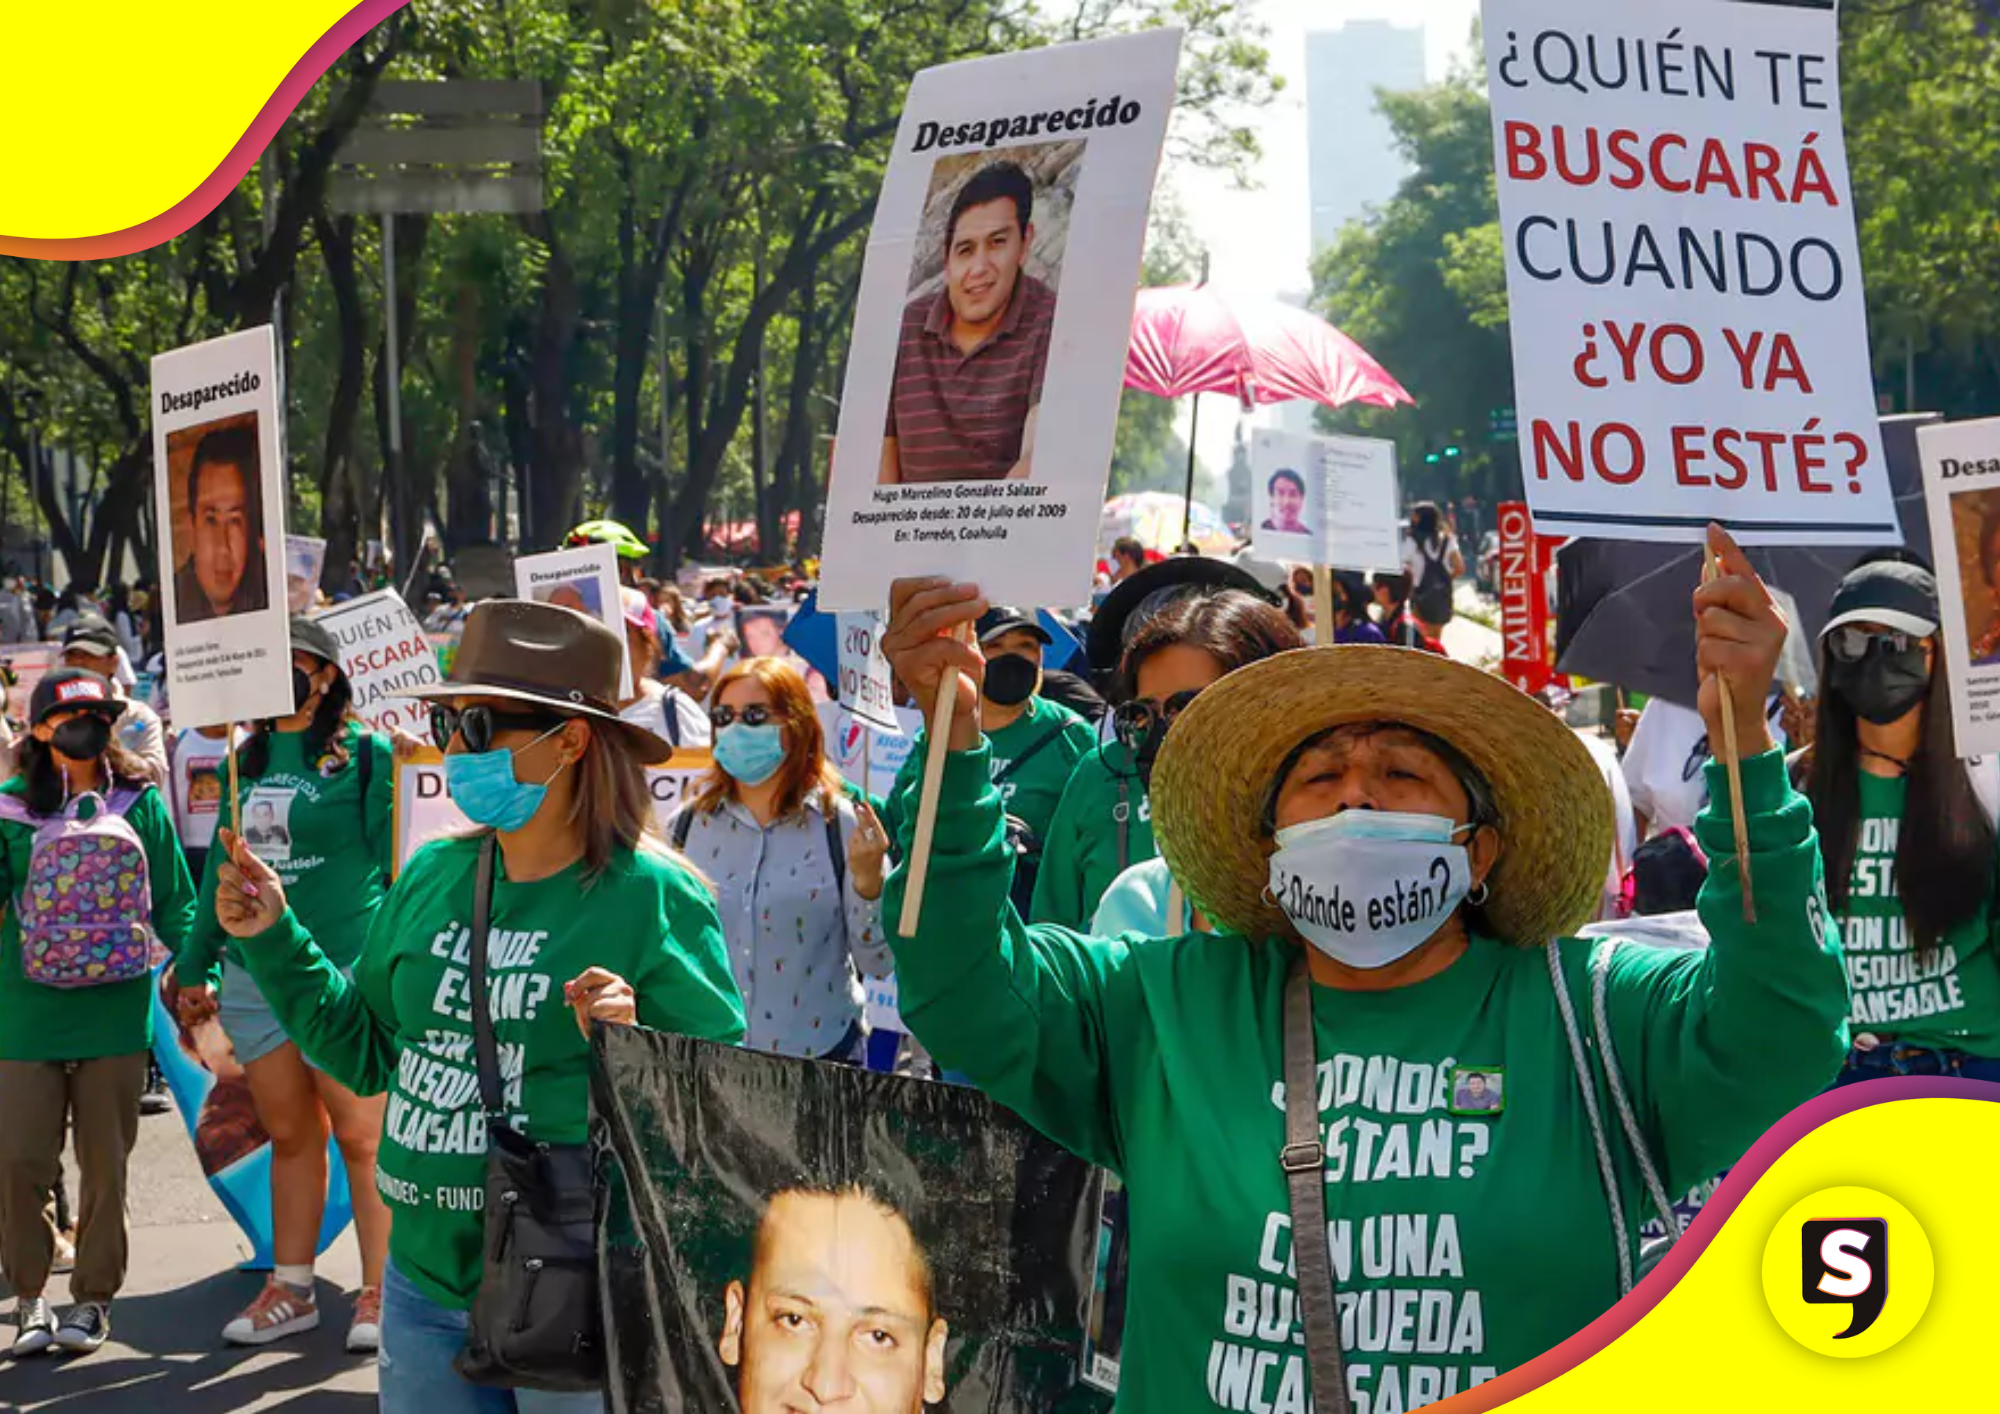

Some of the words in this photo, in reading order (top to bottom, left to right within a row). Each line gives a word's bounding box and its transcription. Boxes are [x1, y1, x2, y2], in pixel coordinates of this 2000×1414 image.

[1499, 27, 1735, 101] ¿QUIÉN
[1754, 51, 1828, 109] TE
[911, 94, 1142, 153] Desaparecido
[1504, 119, 1839, 206] BUSCARÁ
[1516, 215, 1843, 300] CUANDO
[1573, 320, 1705, 388] ¿YO
[1721, 327, 1814, 393] YA
[160, 370, 262, 415] Desaparecido
[1531, 419, 1646, 484] NO
[1670, 418, 1868, 494] ESTÉ?
[852, 507, 918, 525] Desaparecido
[920, 505, 954, 521] desde:
[957, 505, 970, 520] 20
[973, 504, 986, 519] de
[988, 503, 1014, 521] julio
[1016, 503, 1034, 518] del
[1037, 503, 1067, 518] 2009
[872, 488, 899, 504] Hugo
[901, 486, 952, 500] Marcelino
[955, 484, 1003, 499] González
[1008, 483, 1048, 498] Salazar
[894, 528, 910, 542] En:
[913, 527, 956, 542] Torreón,
[960, 525, 1007, 541] Coahuila
[1501, 511, 1530, 660] MILENIO
[1367, 856, 1450, 931] están?
[1846, 974, 1966, 1025] ANSABLE
[1318, 1115, 1490, 1184] STAN?
[436, 1185, 485, 1211] FUND
[1360, 1213, 1464, 1278] UNA
